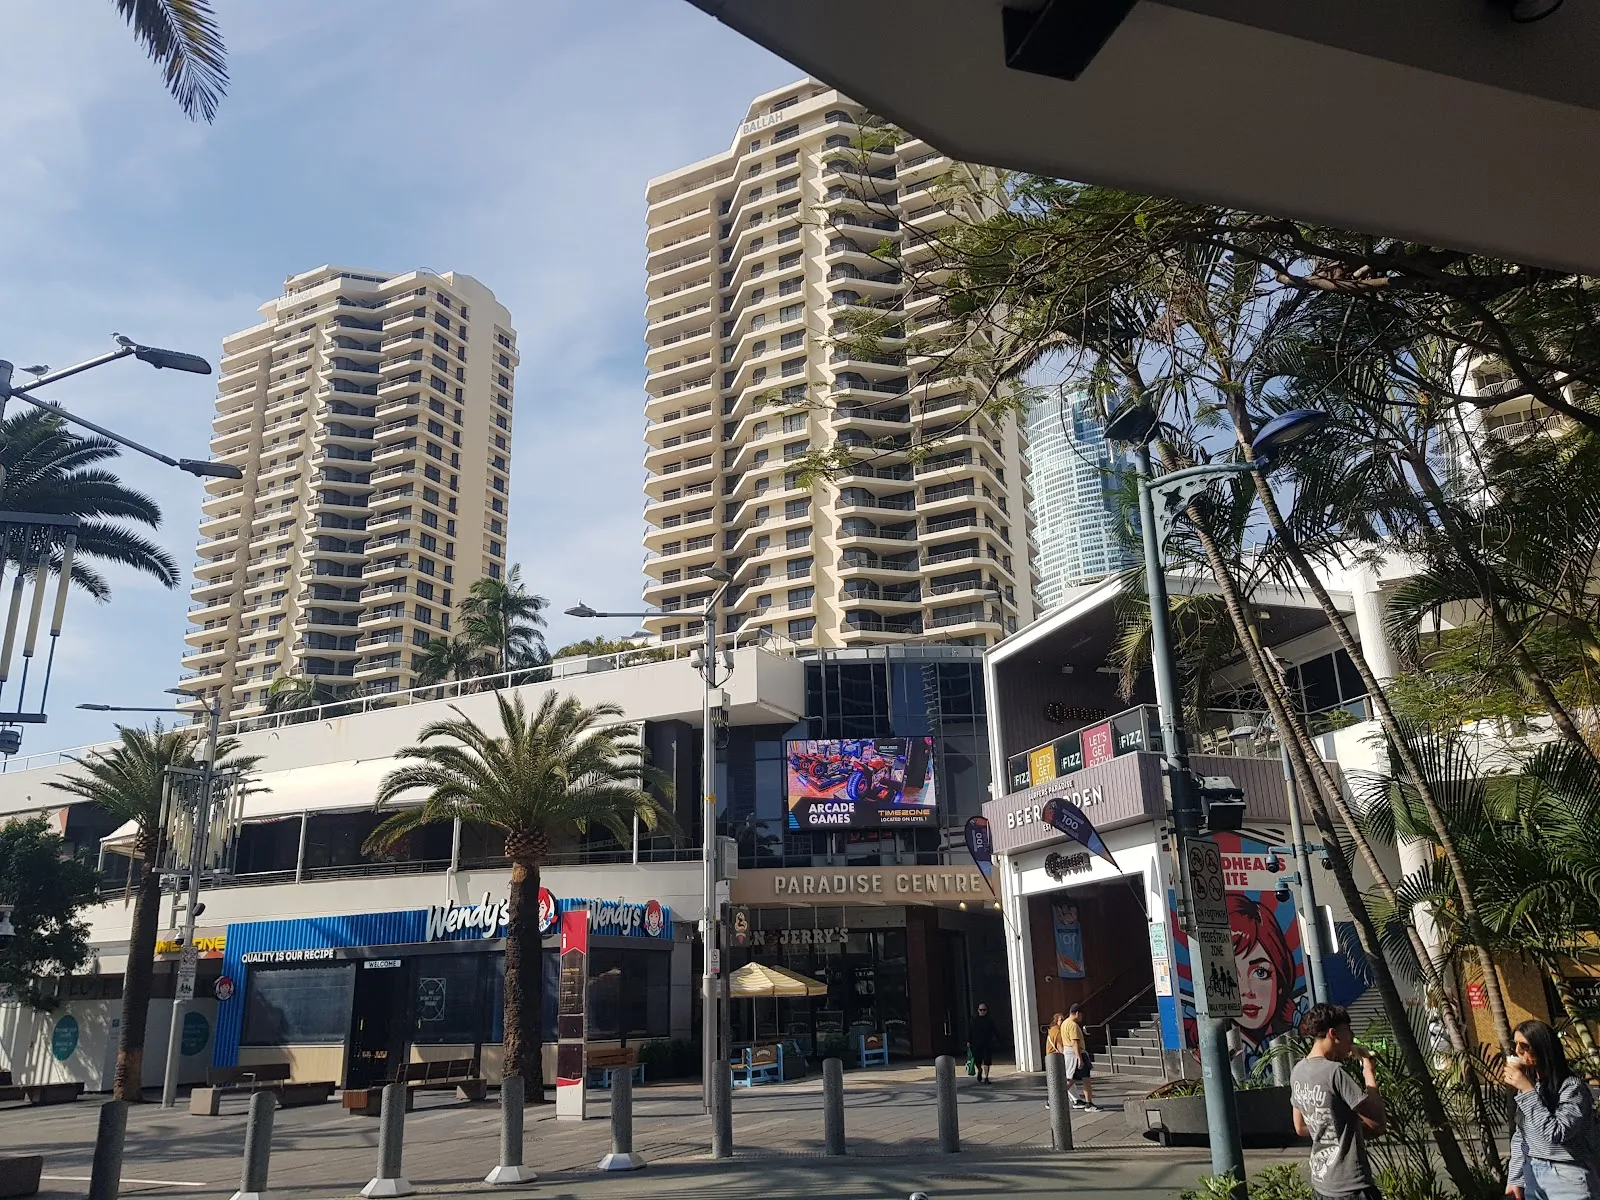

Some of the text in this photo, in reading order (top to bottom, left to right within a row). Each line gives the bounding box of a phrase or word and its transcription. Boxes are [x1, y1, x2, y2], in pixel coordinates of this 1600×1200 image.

[743, 110, 784, 135] BALLAH
[1088, 731, 1107, 747] LET'S
[1121, 730, 1142, 749] FIZZ
[1092, 744, 1107, 758] GET
[1035, 752, 1051, 768] LET'S
[1063, 752, 1081, 769] FIZZ
[1038, 764, 1051, 777] GET
[1048, 780, 1075, 795] PARADISE
[808, 802, 855, 813] ARCADE
[808, 813, 851, 824] GAMES
[1007, 805, 1042, 829] BEER
[1061, 814, 1079, 831] 100
[975, 832, 984, 849] 100
[1222, 857, 1287, 872] DHEAS
[774, 873, 983, 895] PARADISE CENTRE
[426, 891, 510, 941] Wendy's
[589, 896, 642, 936] Wendy's
[1204, 909, 1226, 919] FOOTPATH
[779, 926, 849, 945] JERRY'S
[1200, 931, 1230, 944] PEDESTRIAN
[241, 949, 334, 963] QUALITY IS OUR RECIPE
[1210, 944, 1224, 957] ZONE
[368, 960, 397, 968] WELCOME
